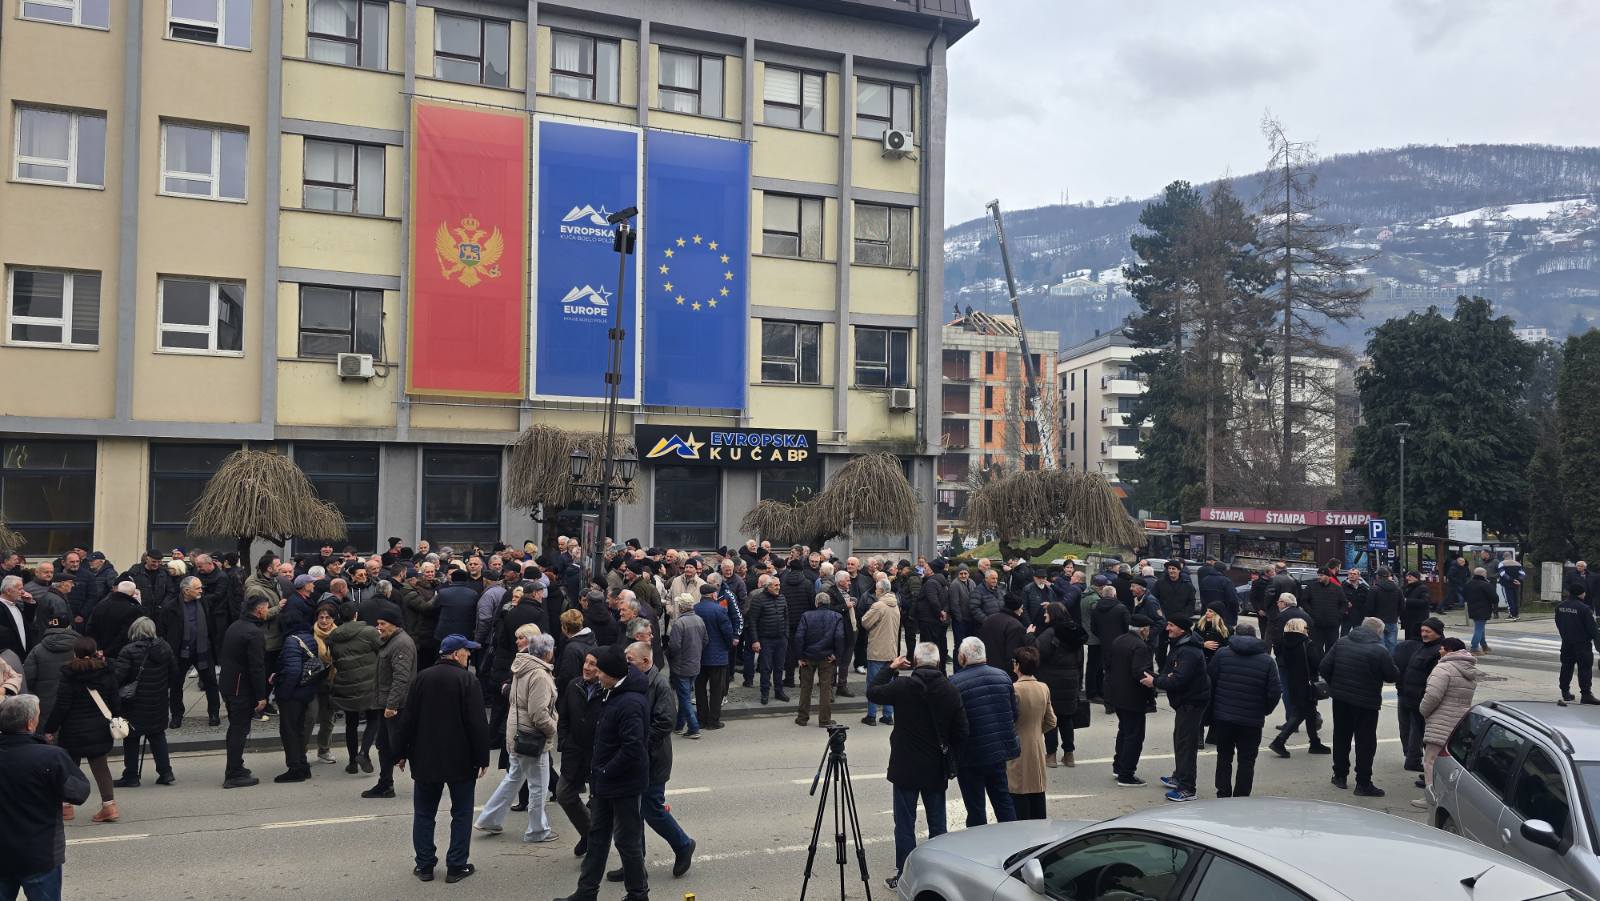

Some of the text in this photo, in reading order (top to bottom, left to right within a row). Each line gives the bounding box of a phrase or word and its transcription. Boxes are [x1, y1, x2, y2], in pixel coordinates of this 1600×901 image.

[560, 225, 616, 238] EVROPSKA
[563, 305, 608, 316] EUROPE
[710, 431, 809, 447] EVROPSKA
[709, 446, 808, 462] KUĆA BP
[1210, 508, 1245, 521] ŠTAMPA
[1265, 510, 1306, 524] ŠTAMPA
[1372, 522, 1383, 538] P
